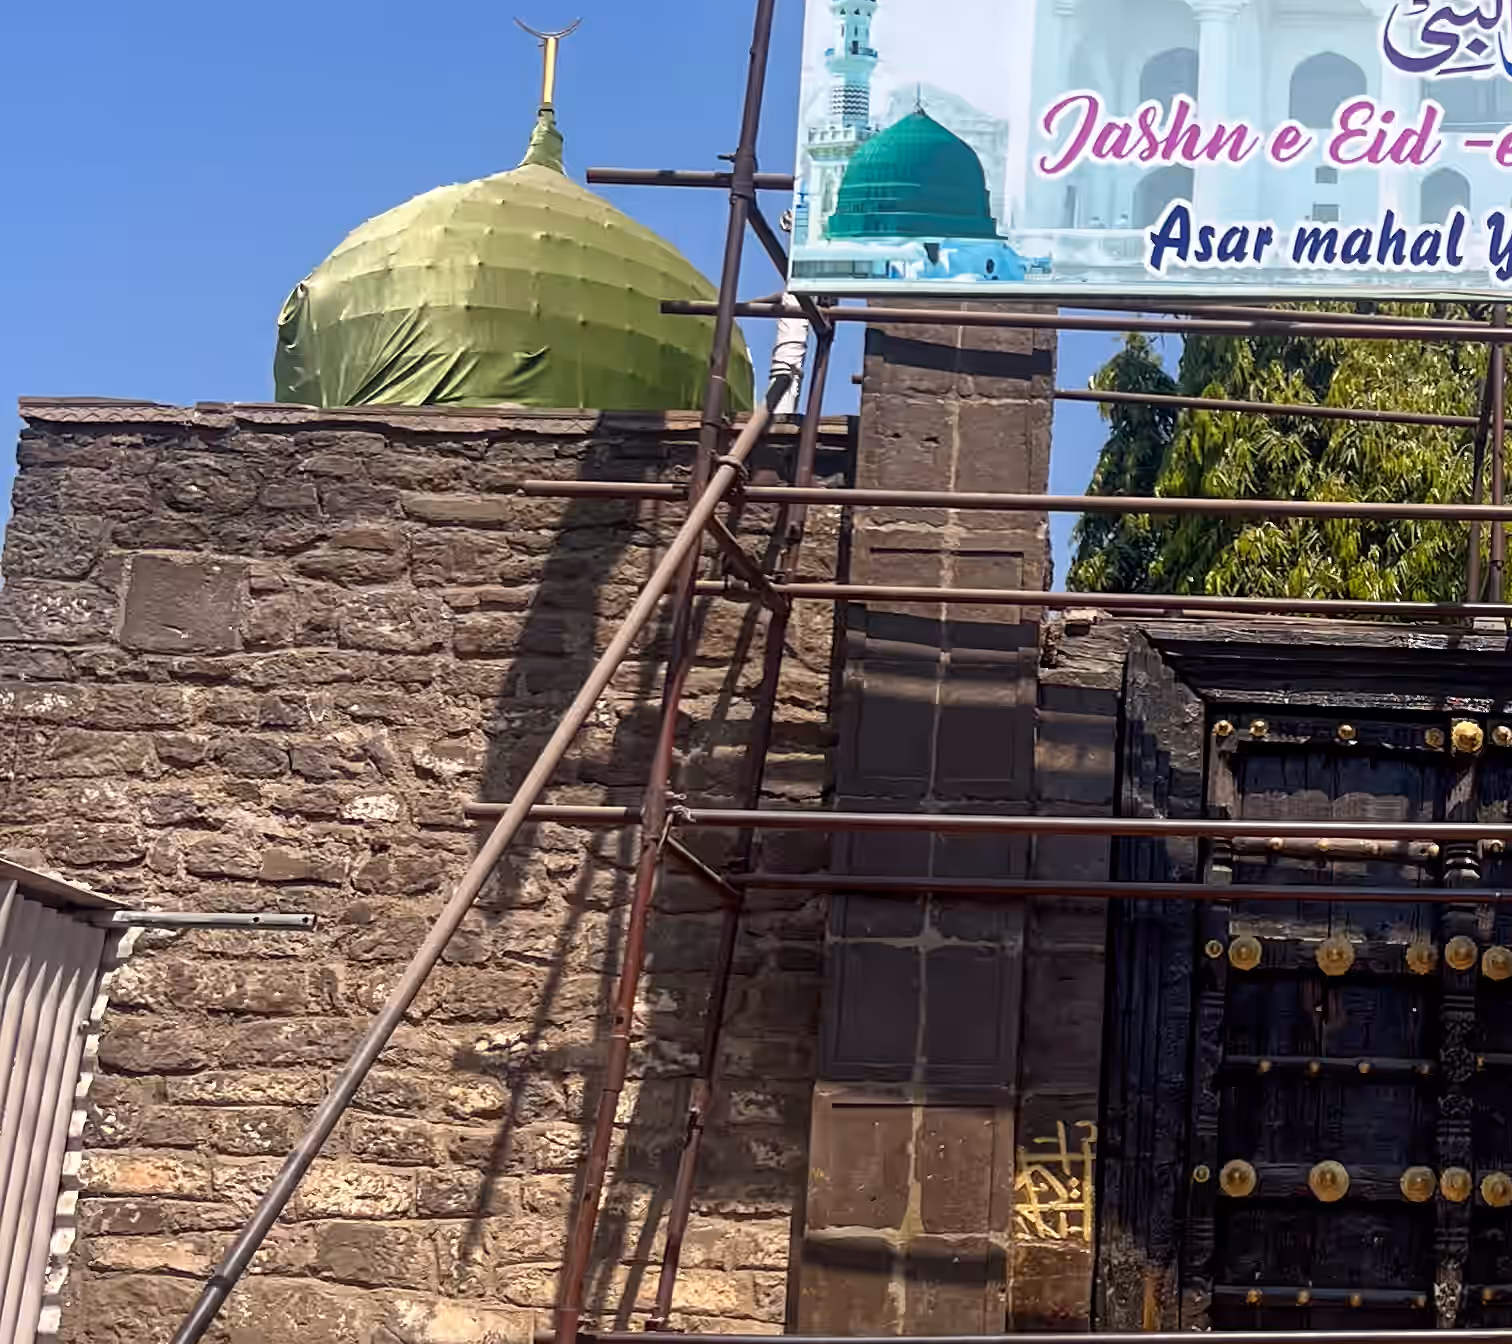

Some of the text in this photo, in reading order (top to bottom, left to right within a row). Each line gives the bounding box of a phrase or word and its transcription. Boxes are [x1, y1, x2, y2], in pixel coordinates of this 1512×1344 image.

[1040, 95, 1258, 174] Jashn
[1271, 119, 1312, 162] e
[1328, 100, 1442, 166] Eid
[1150, 204, 1274, 272] Asar
[1292, 208, 1464, 268] mahal
